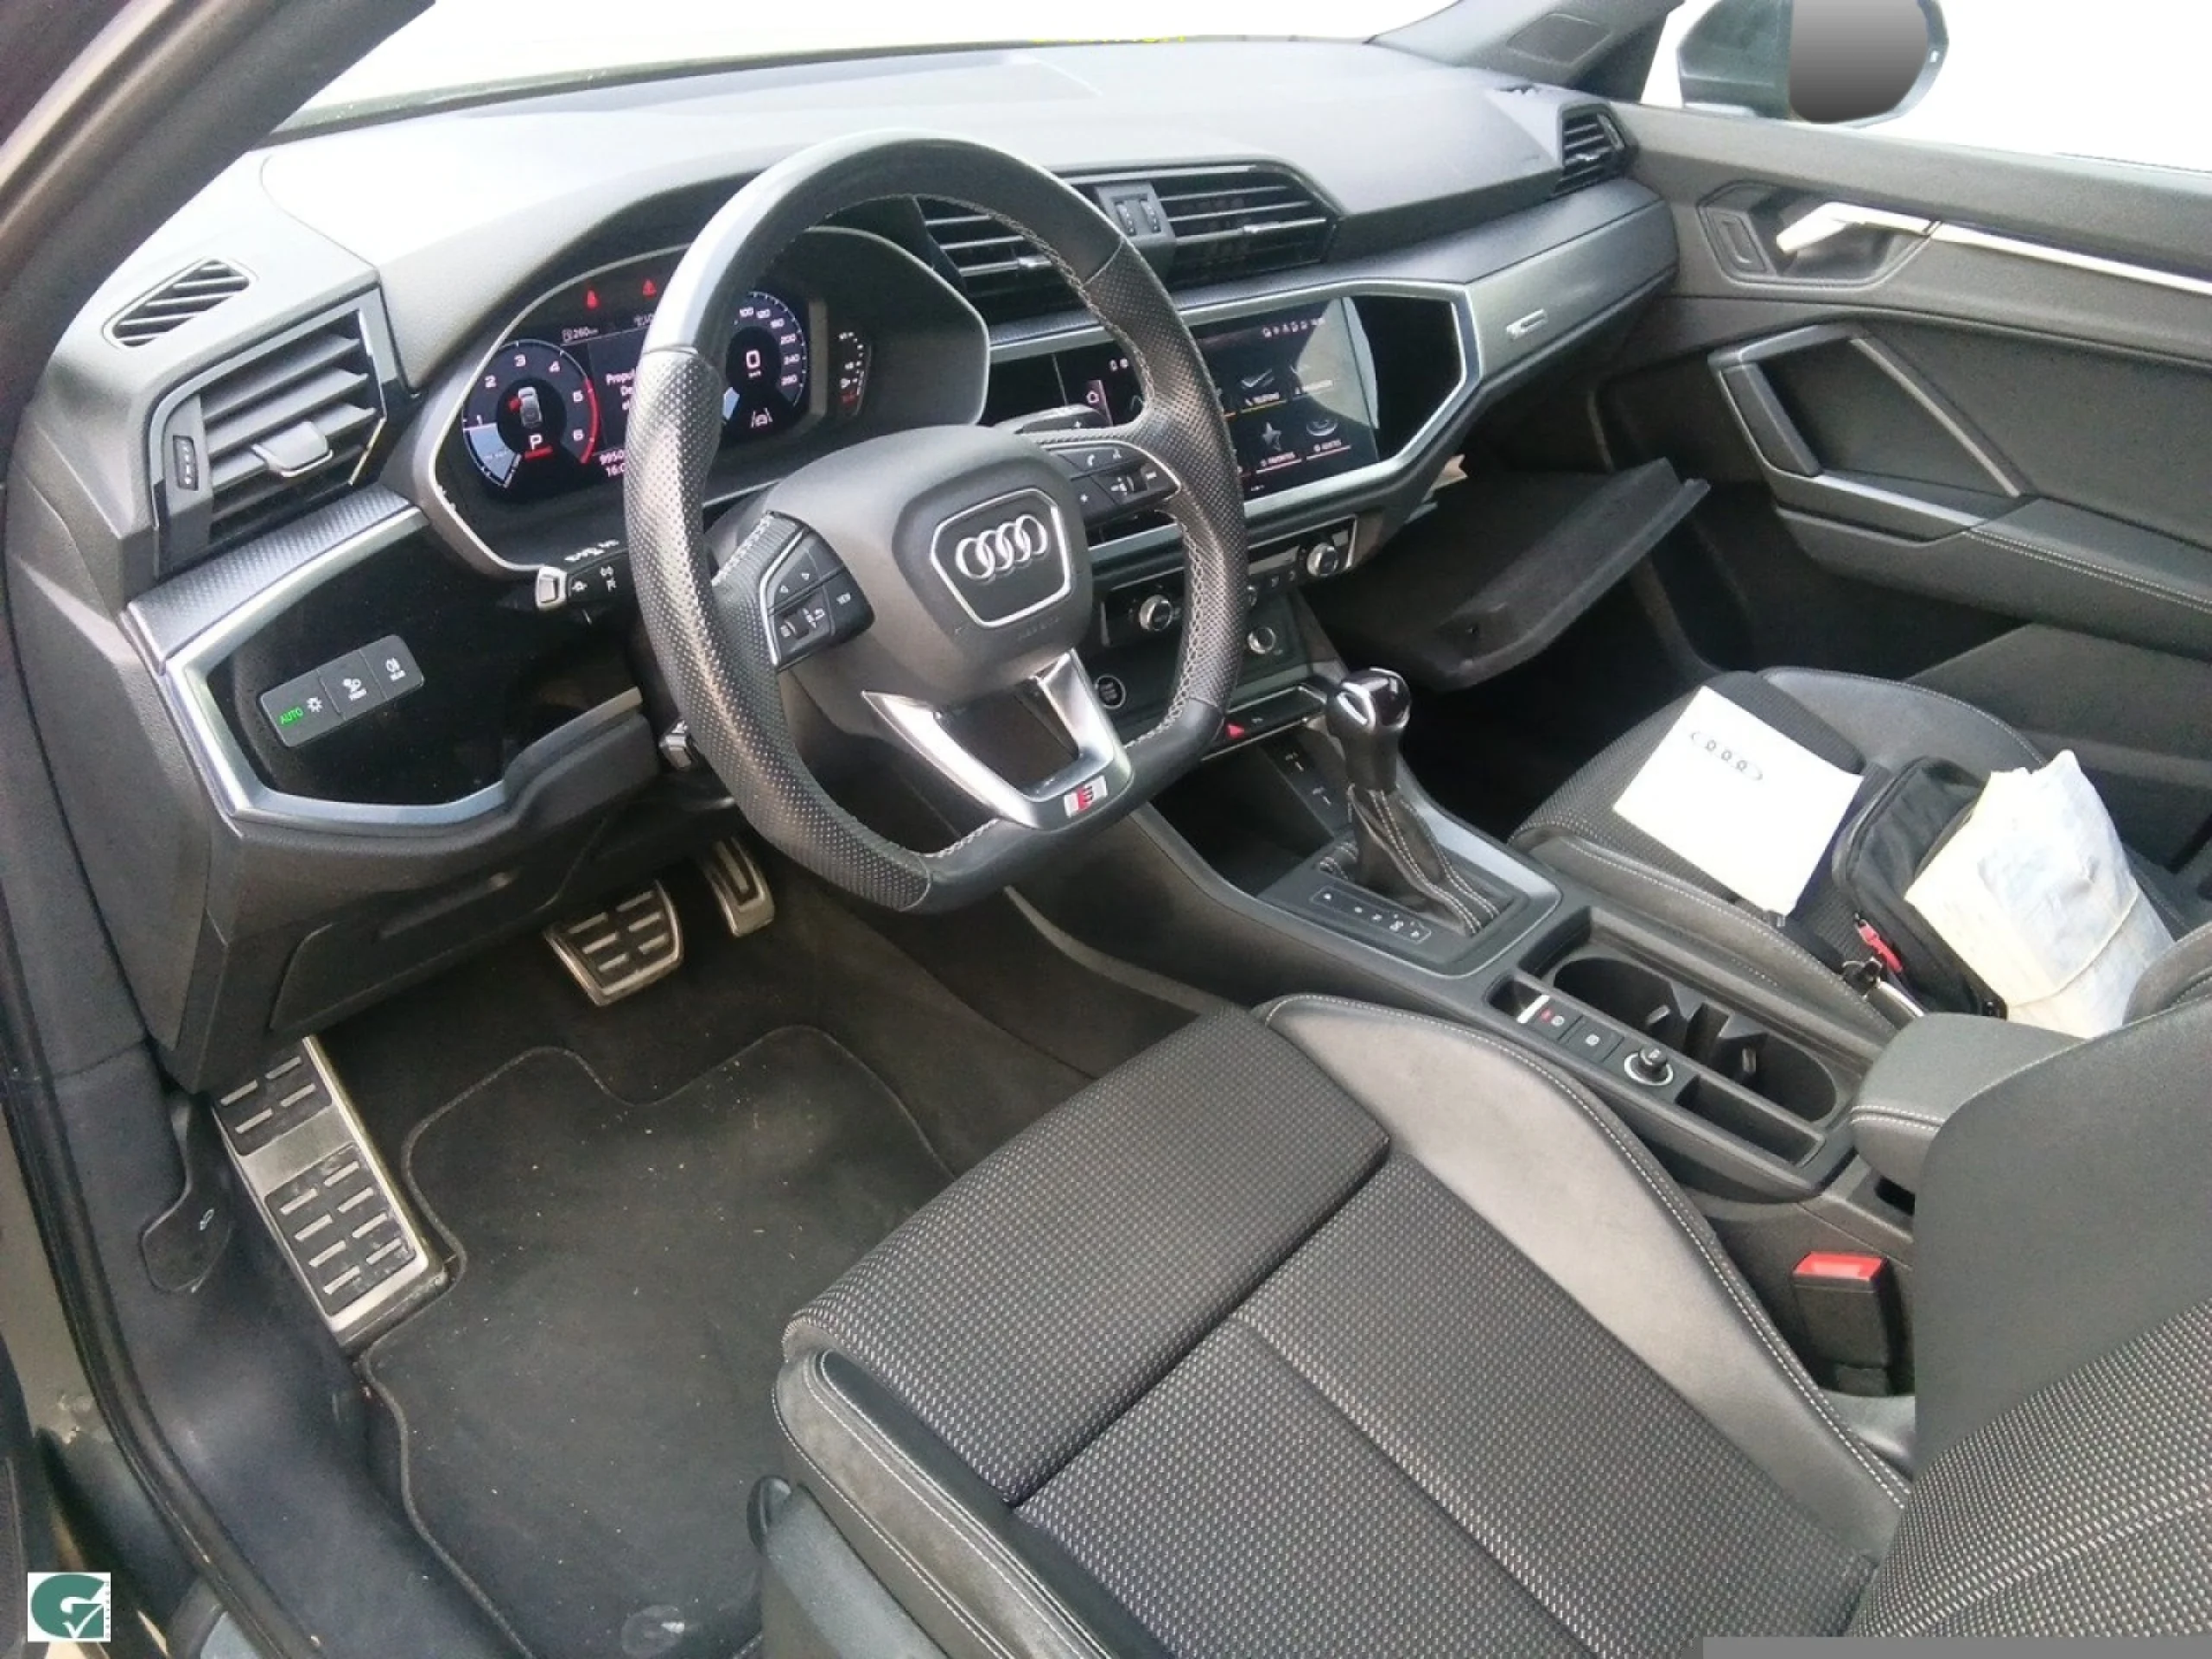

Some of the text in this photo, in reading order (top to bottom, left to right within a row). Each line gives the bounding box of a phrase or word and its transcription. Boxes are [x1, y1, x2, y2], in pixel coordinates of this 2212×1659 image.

[514, 354, 526, 367] 3
[746, 350, 761, 369] 0
[549, 360, 561, 373] 4
[485, 375, 497, 388] 2
[573, 391, 583, 402] 5
[529, 435, 543, 449] P
[573, 429, 584, 442] 6
[280, 706, 303, 725] AUTO
